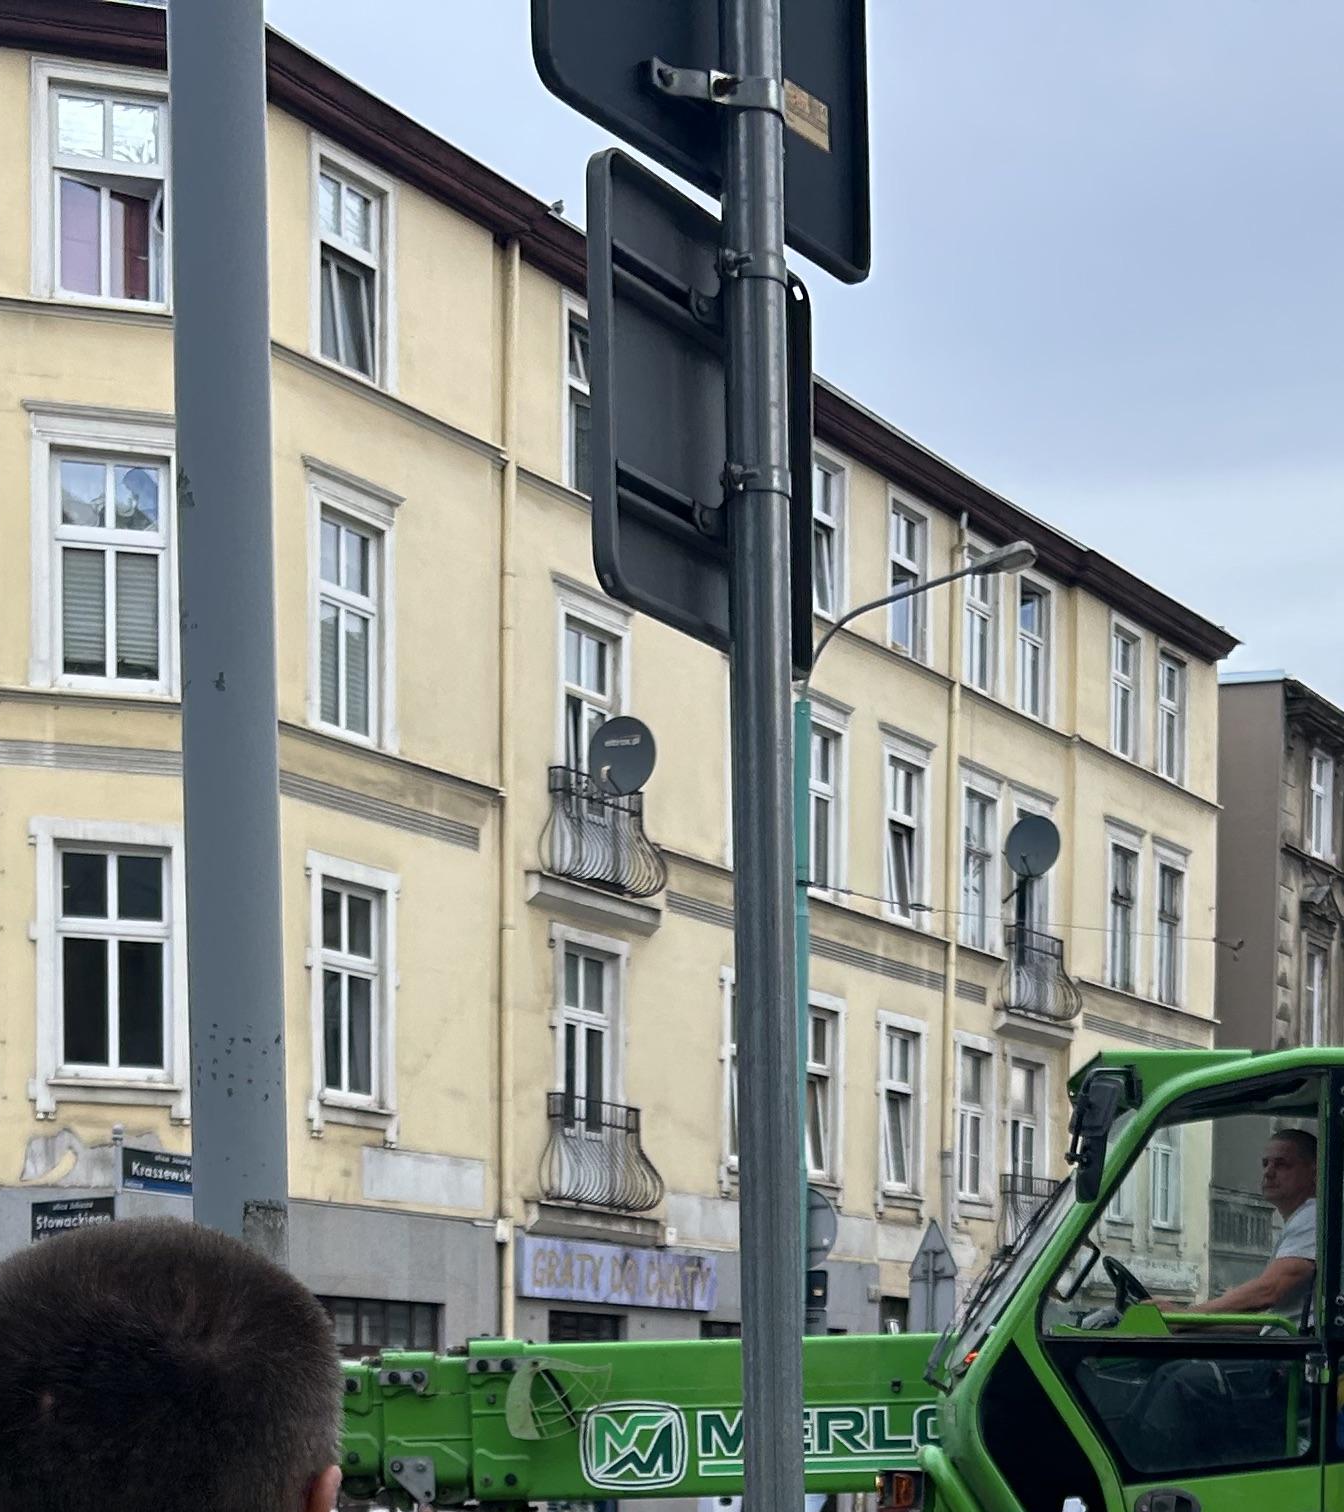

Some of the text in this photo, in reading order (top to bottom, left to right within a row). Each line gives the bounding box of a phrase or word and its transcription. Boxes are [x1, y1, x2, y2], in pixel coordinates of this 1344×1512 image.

[131, 1161, 192, 1184] Kraszewsk
[533, 1248, 712, 1310] GRATY DO CHATY
[696, 1406, 940, 1458] MRL
